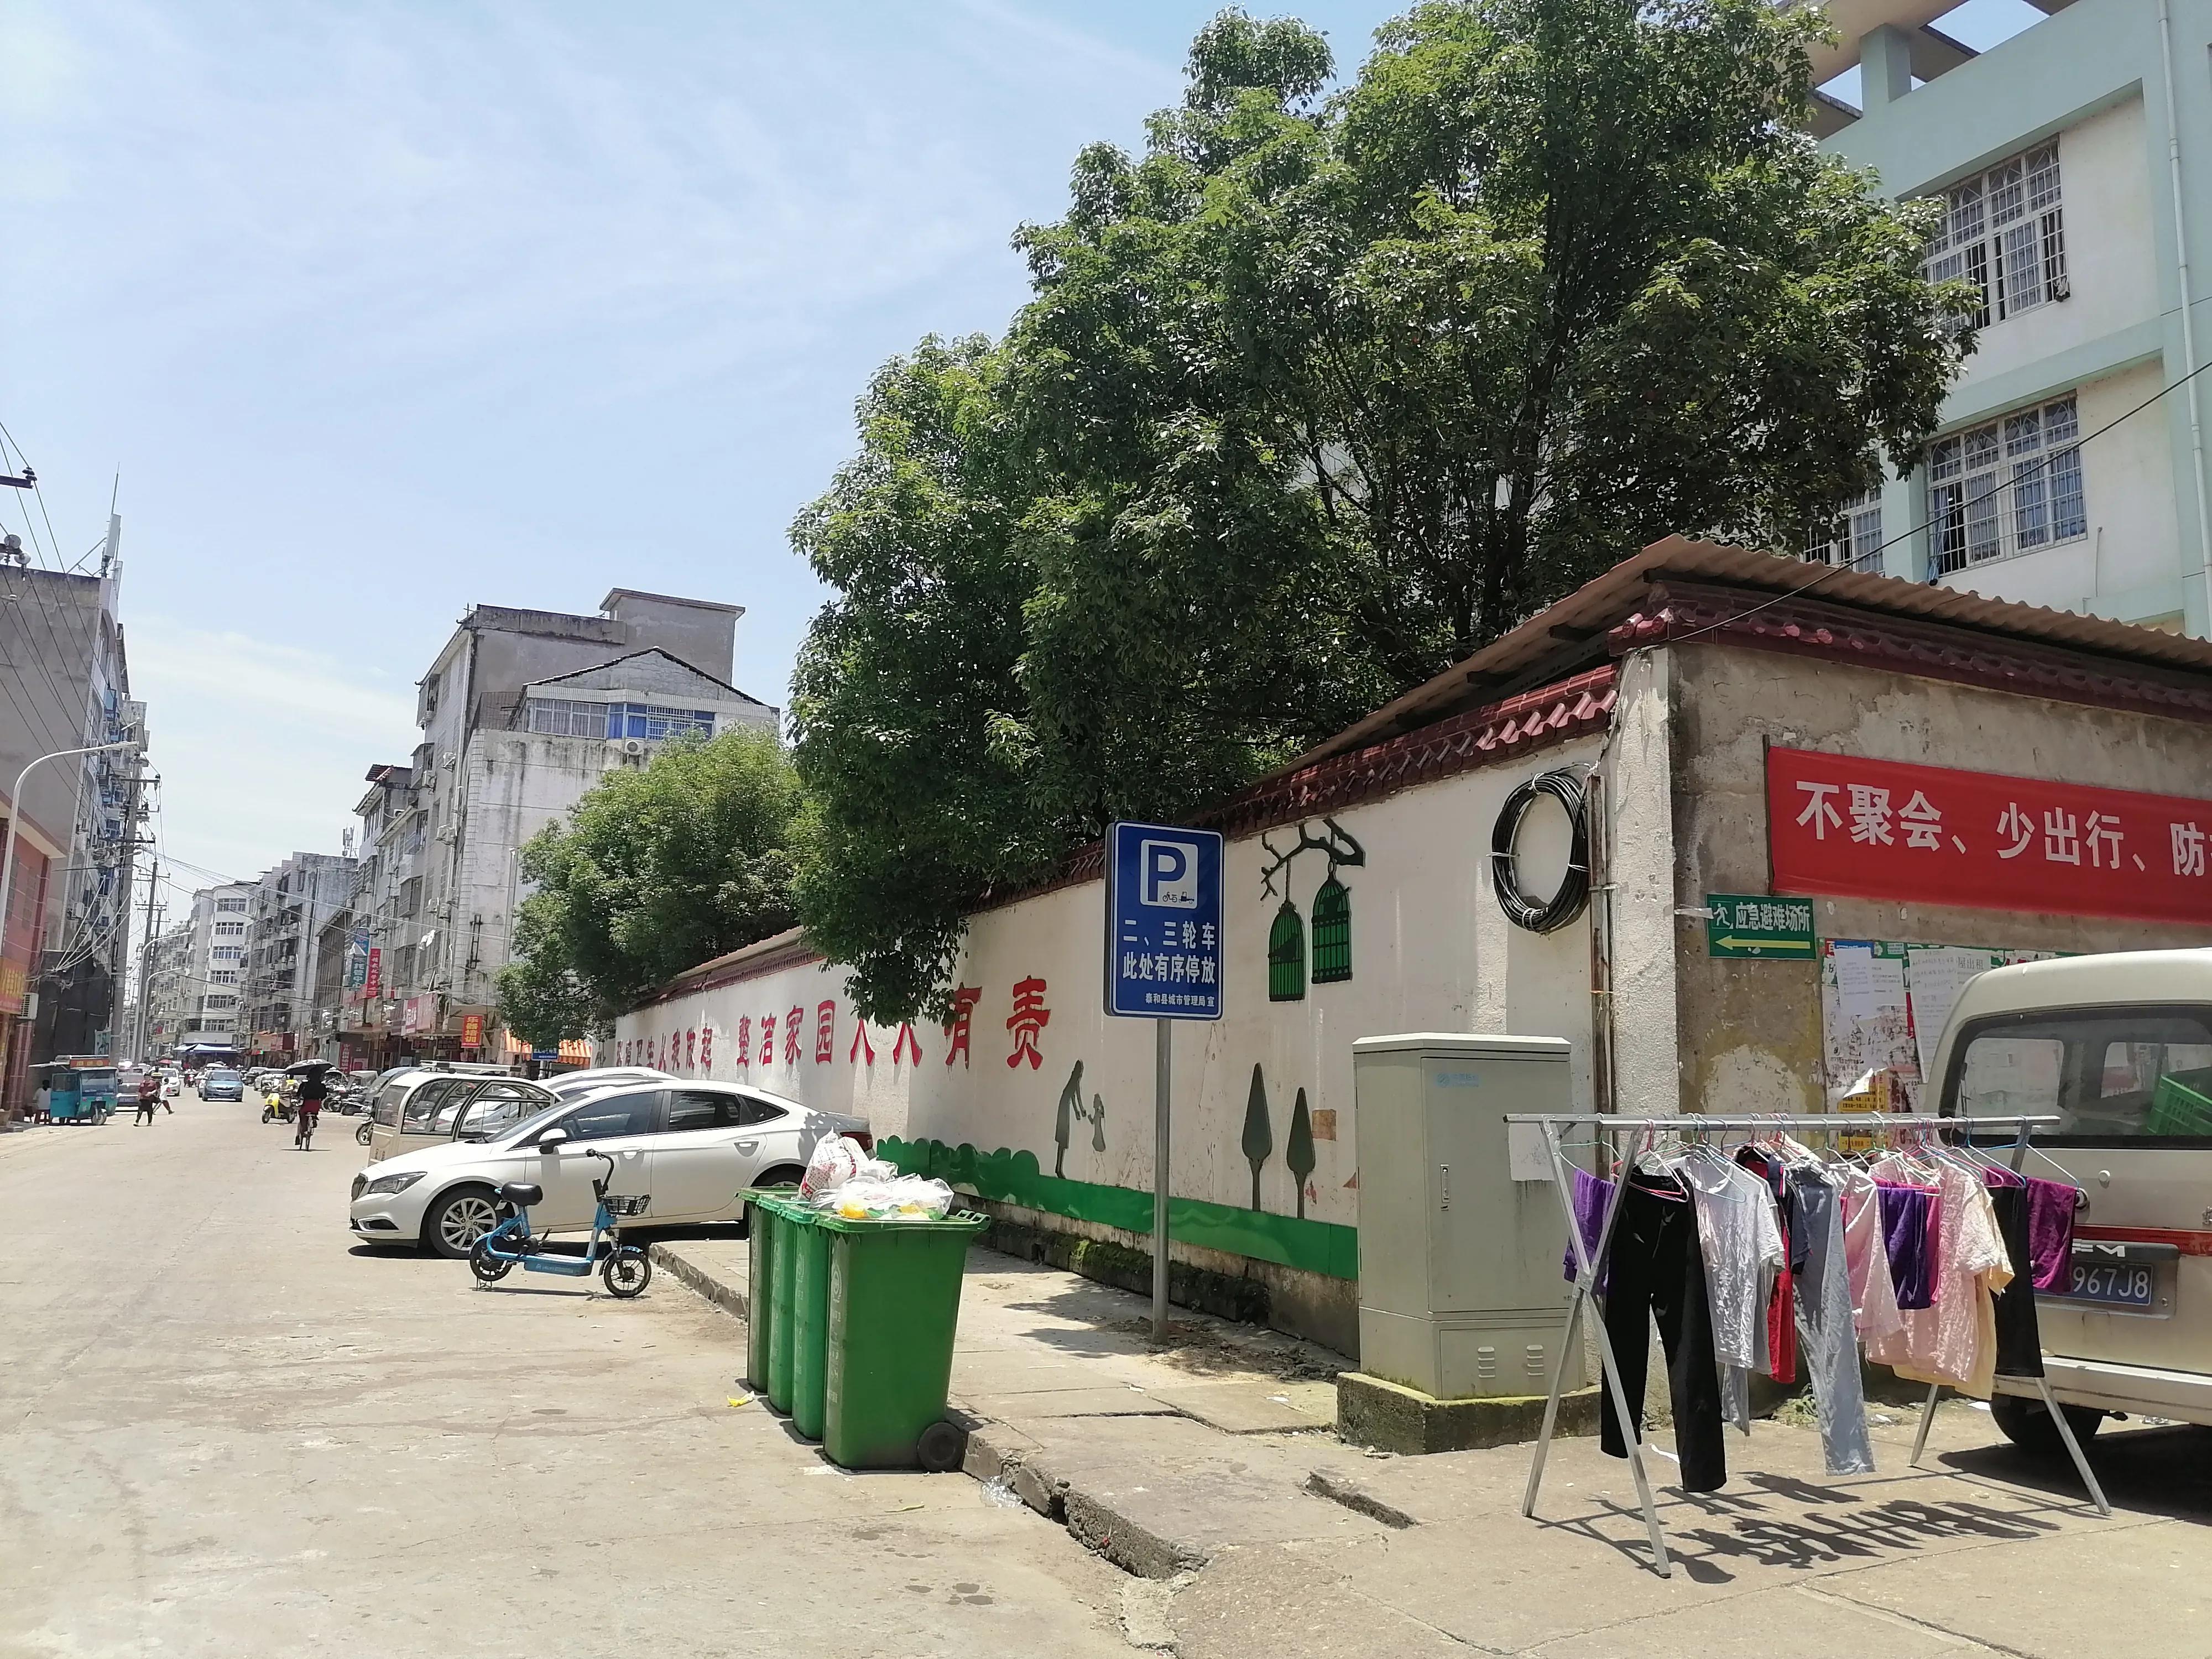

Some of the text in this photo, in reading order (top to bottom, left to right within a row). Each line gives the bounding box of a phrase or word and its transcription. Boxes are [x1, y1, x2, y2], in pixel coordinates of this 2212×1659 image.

[1795, 780, 2212, 877] 不聚会、少出行、防
[1147, 844, 1187, 902] P
[1735, 901, 1810, 932] 应急避难场所
[1123, 919, 1215, 951] 二、三轮车
[1122, 951, 1216, 984] 此处有序停放
